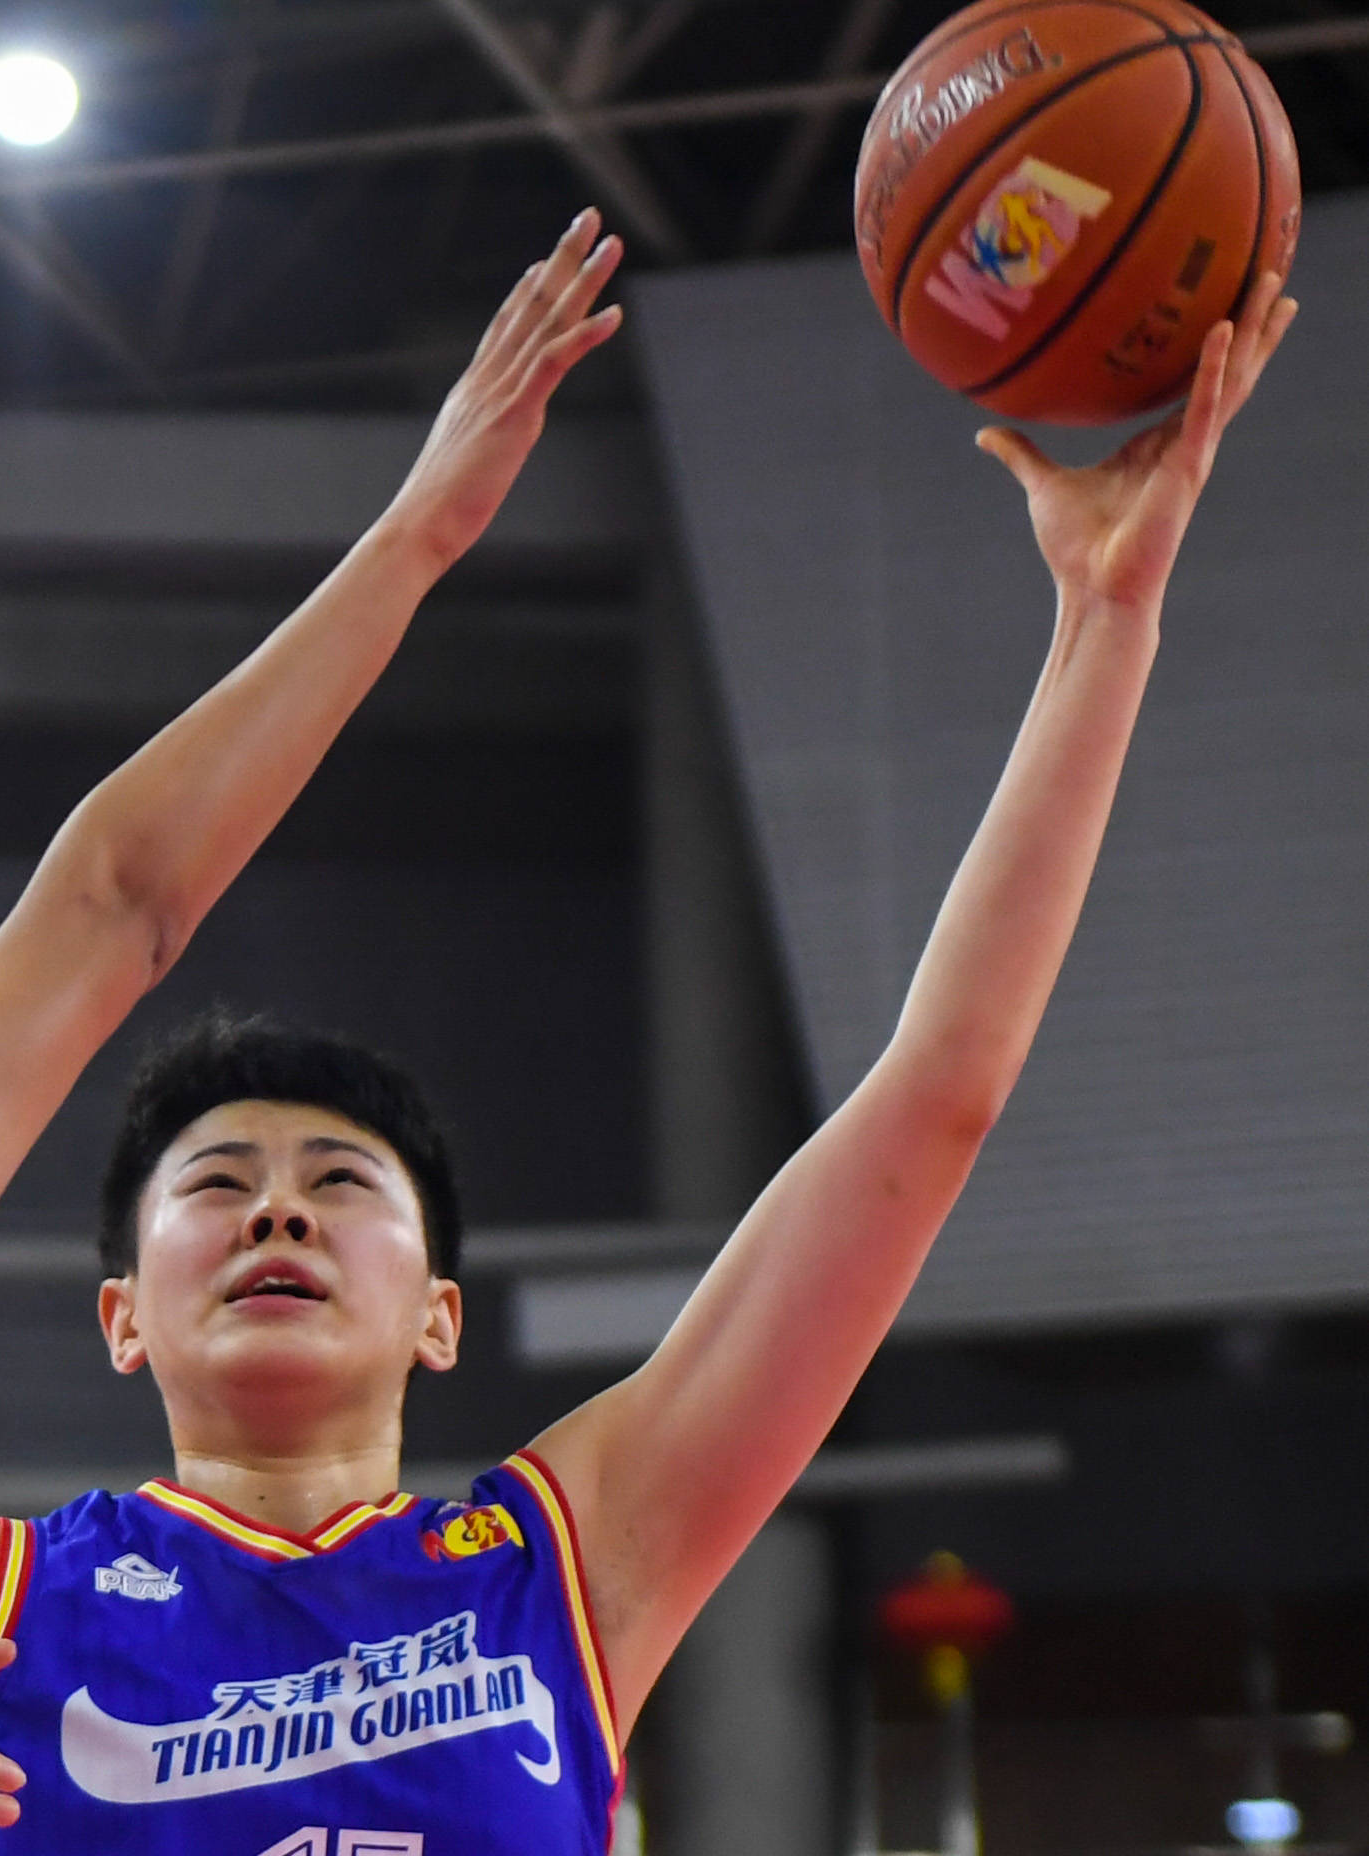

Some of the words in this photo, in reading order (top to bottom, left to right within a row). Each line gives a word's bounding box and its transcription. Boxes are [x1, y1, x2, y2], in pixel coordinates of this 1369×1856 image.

[214, 1613, 475, 1720] 天津冠岚
[151, 1707, 336, 1785] TIANJIN
[350, 1663, 527, 1746] GUANLAN
